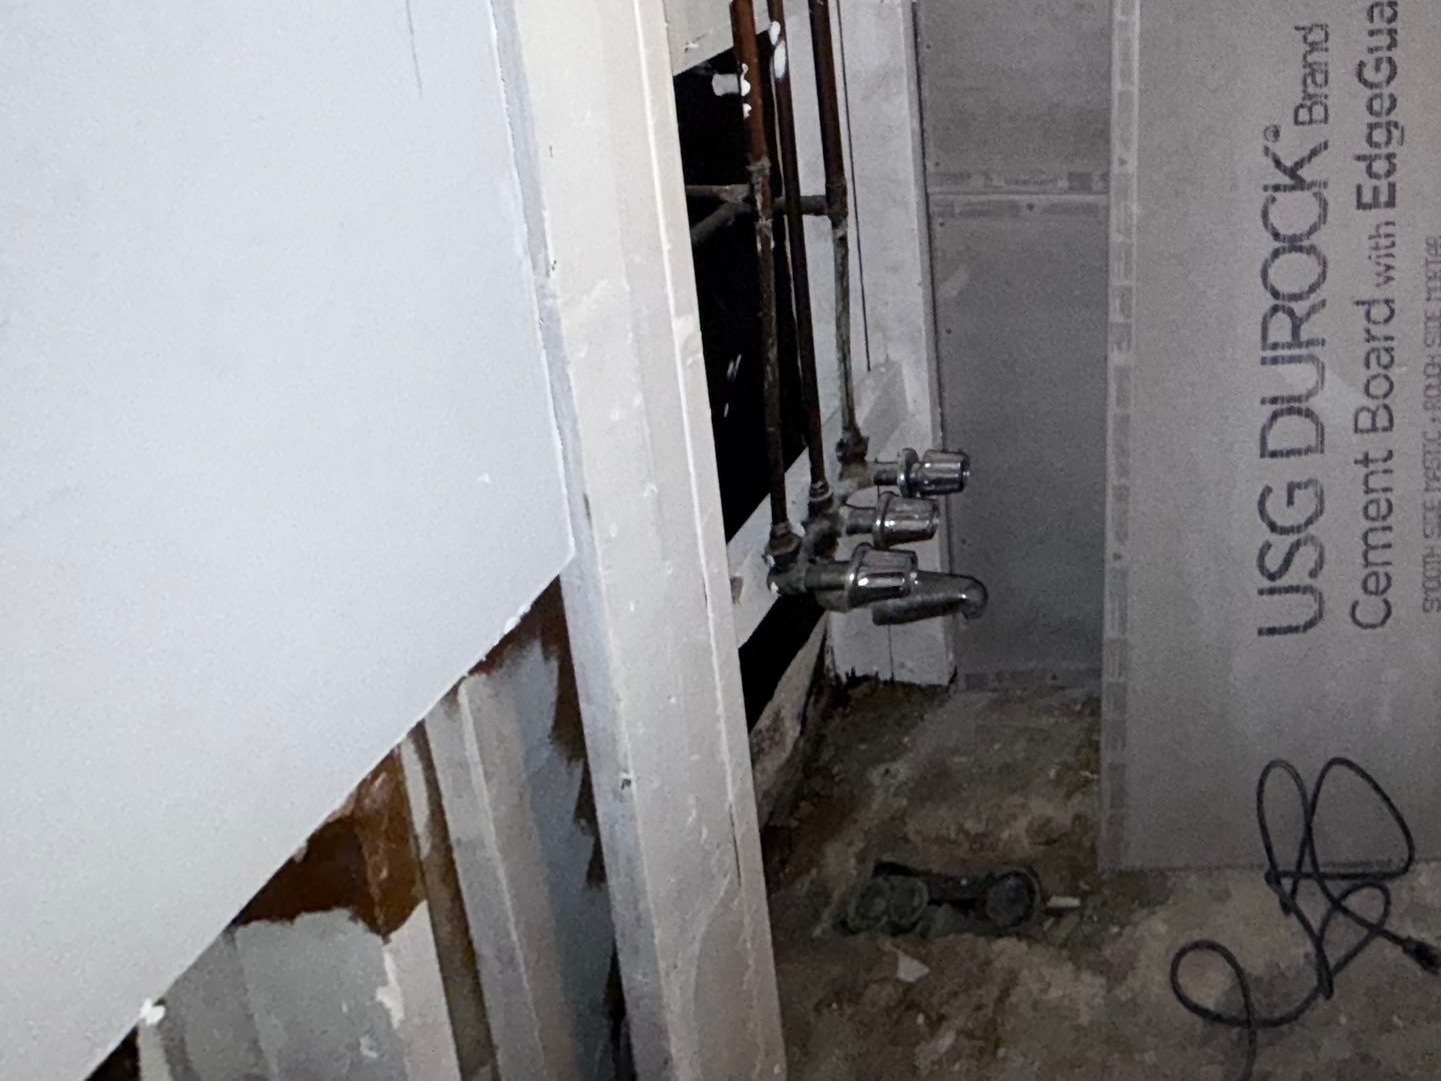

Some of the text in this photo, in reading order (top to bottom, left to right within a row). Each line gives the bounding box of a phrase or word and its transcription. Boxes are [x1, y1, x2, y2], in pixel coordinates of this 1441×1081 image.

[1256, 480, 1326, 639] USG
[1292, 22, 1331, 127] Brand
[1366, 221, 1397, 288] with
[1351, 298, 1396, 434] Board
[1350, 449, 1396, 632] Cement
